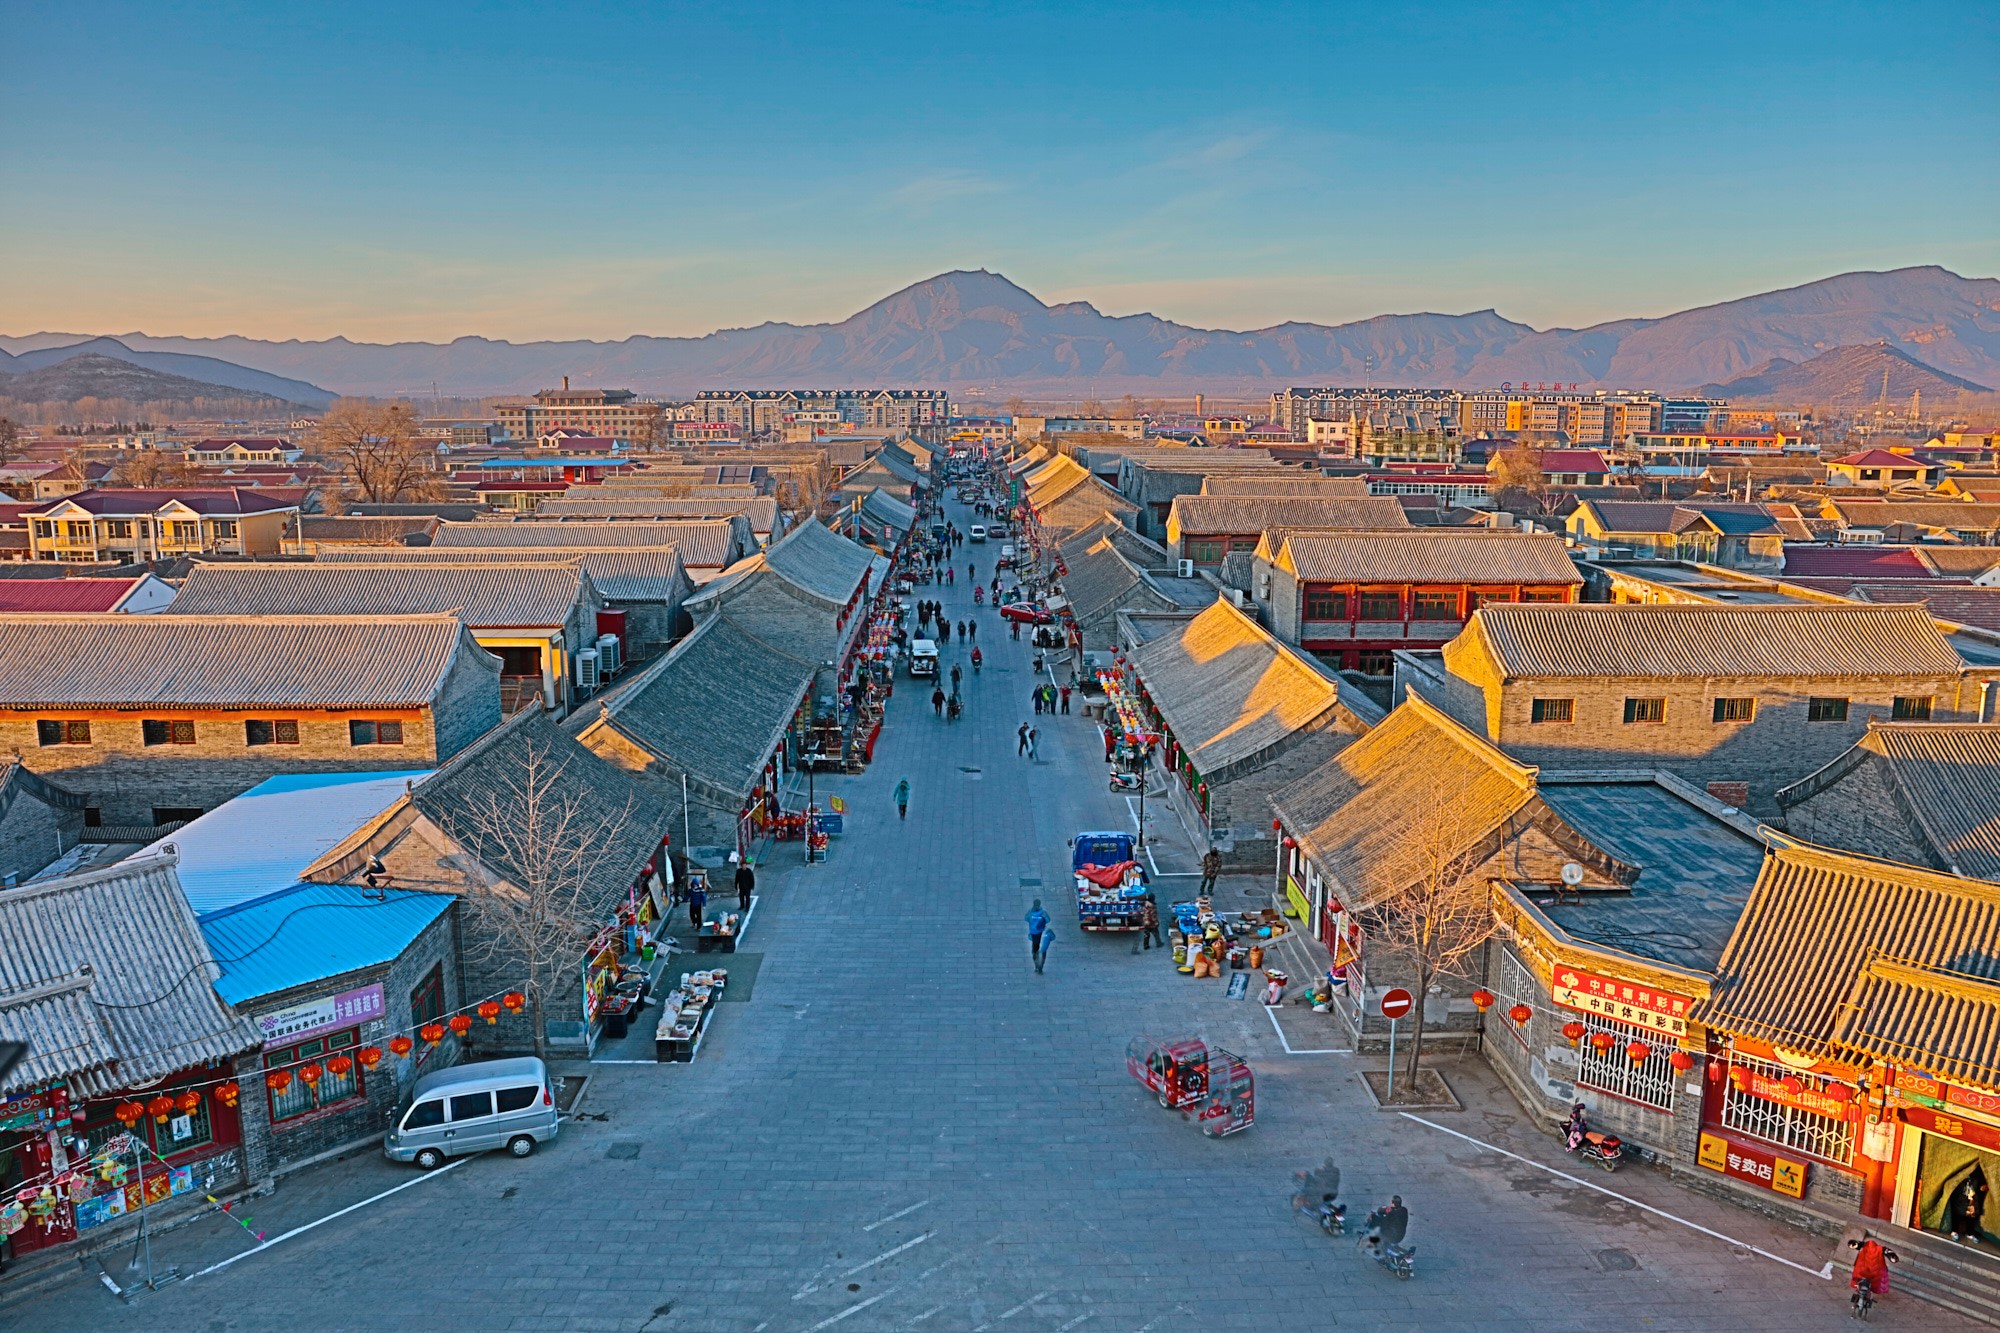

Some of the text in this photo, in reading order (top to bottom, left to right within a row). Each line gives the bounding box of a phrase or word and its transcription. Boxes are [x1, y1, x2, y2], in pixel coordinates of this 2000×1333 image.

[336, 992, 380, 1019] 卡迪隆超市
[1589, 989, 1681, 1017] CHINA WELFARE LOTTERY
[1590, 979, 1684, 1014] 中国福利彩票
[1590, 998, 1683, 1033] 中国体育彩票
[1935, 1115, 1964, 1136] 彩
[1727, 1153, 1773, 1181] 专卖店
